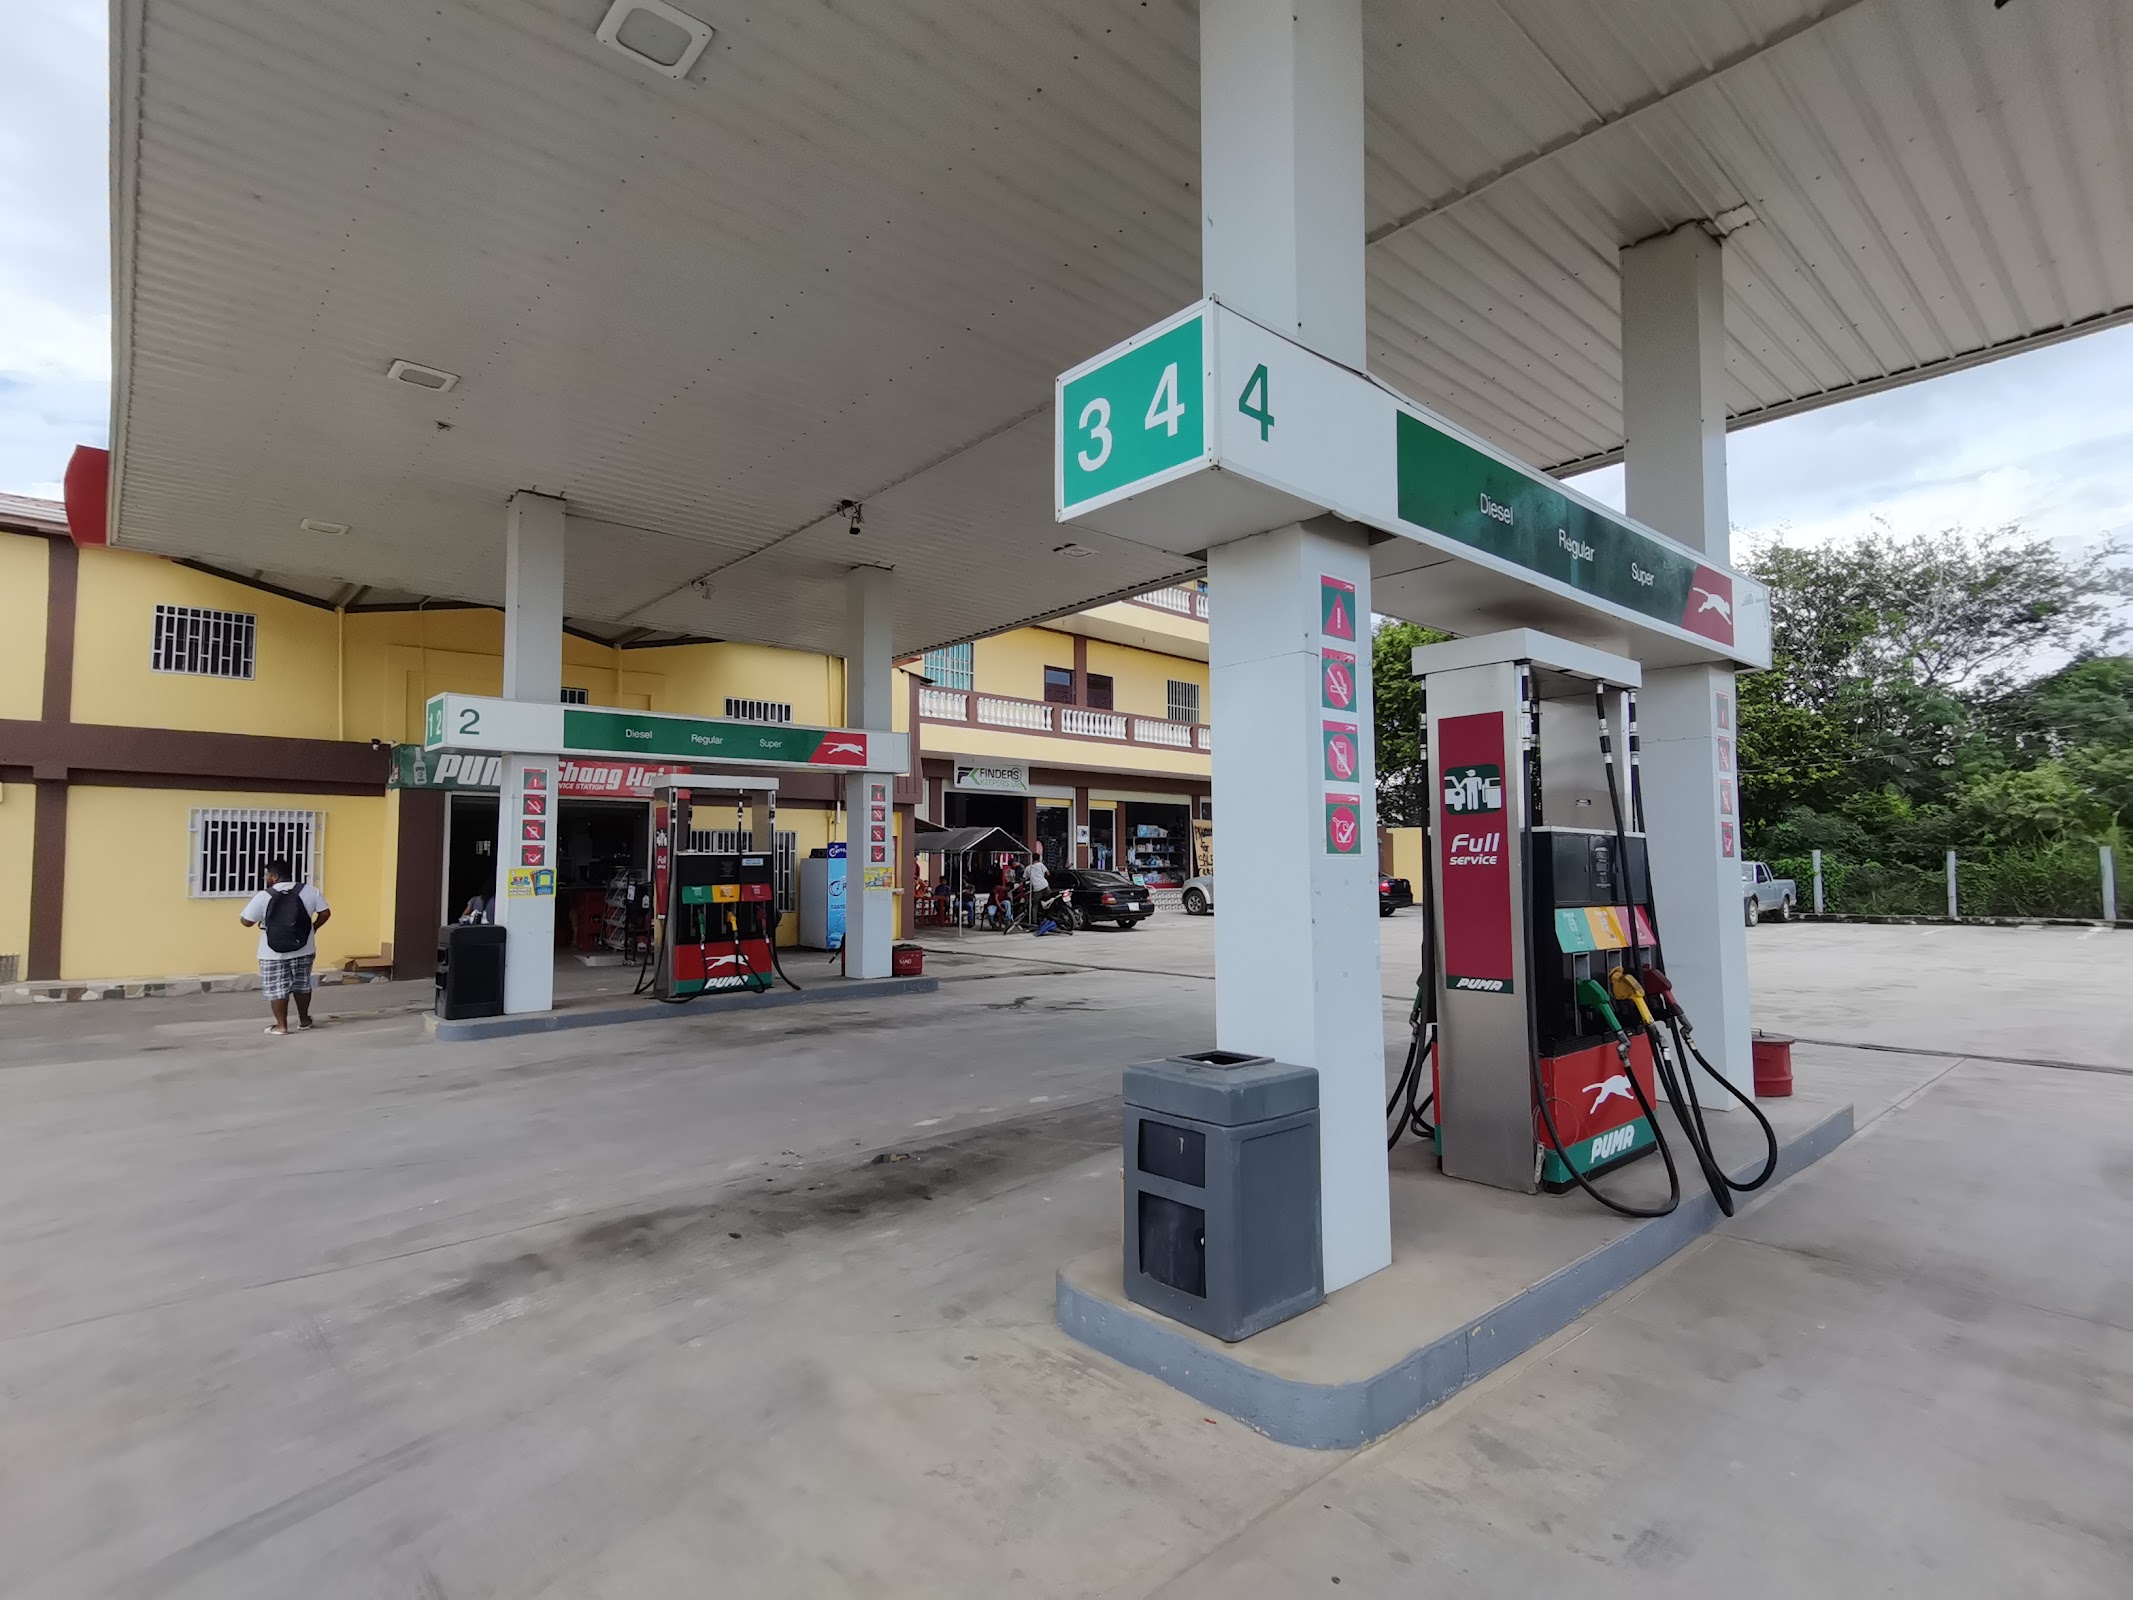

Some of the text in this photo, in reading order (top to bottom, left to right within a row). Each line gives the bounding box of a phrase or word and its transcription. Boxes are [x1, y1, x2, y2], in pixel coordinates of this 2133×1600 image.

[1238, 363, 1275, 443] 4
[1077, 361, 1186, 472] 3 4
[1480, 492, 1515, 526] Diesel
[1558, 528, 1595, 562] Regular
[1631, 562, 1655, 587] Super
[428, 710, 442, 738] 1 2
[459, 708, 480, 735] 2
[625, 728, 653, 740] Diesel
[691, 733, 723, 746] Regular
[759, 738, 782, 749] Super
[433, 753, 502, 787] PUM
[979, 767, 1020, 781] FINDERS
[575, 783, 605, 791] STATION
[1450, 832, 1500, 853] Full
[1449, 853, 1498, 866] service
[704, 975, 749, 989] PUMA
[1456, 978, 1504, 991] PUMA
[1589, 1124, 1635, 1165] PUMA
